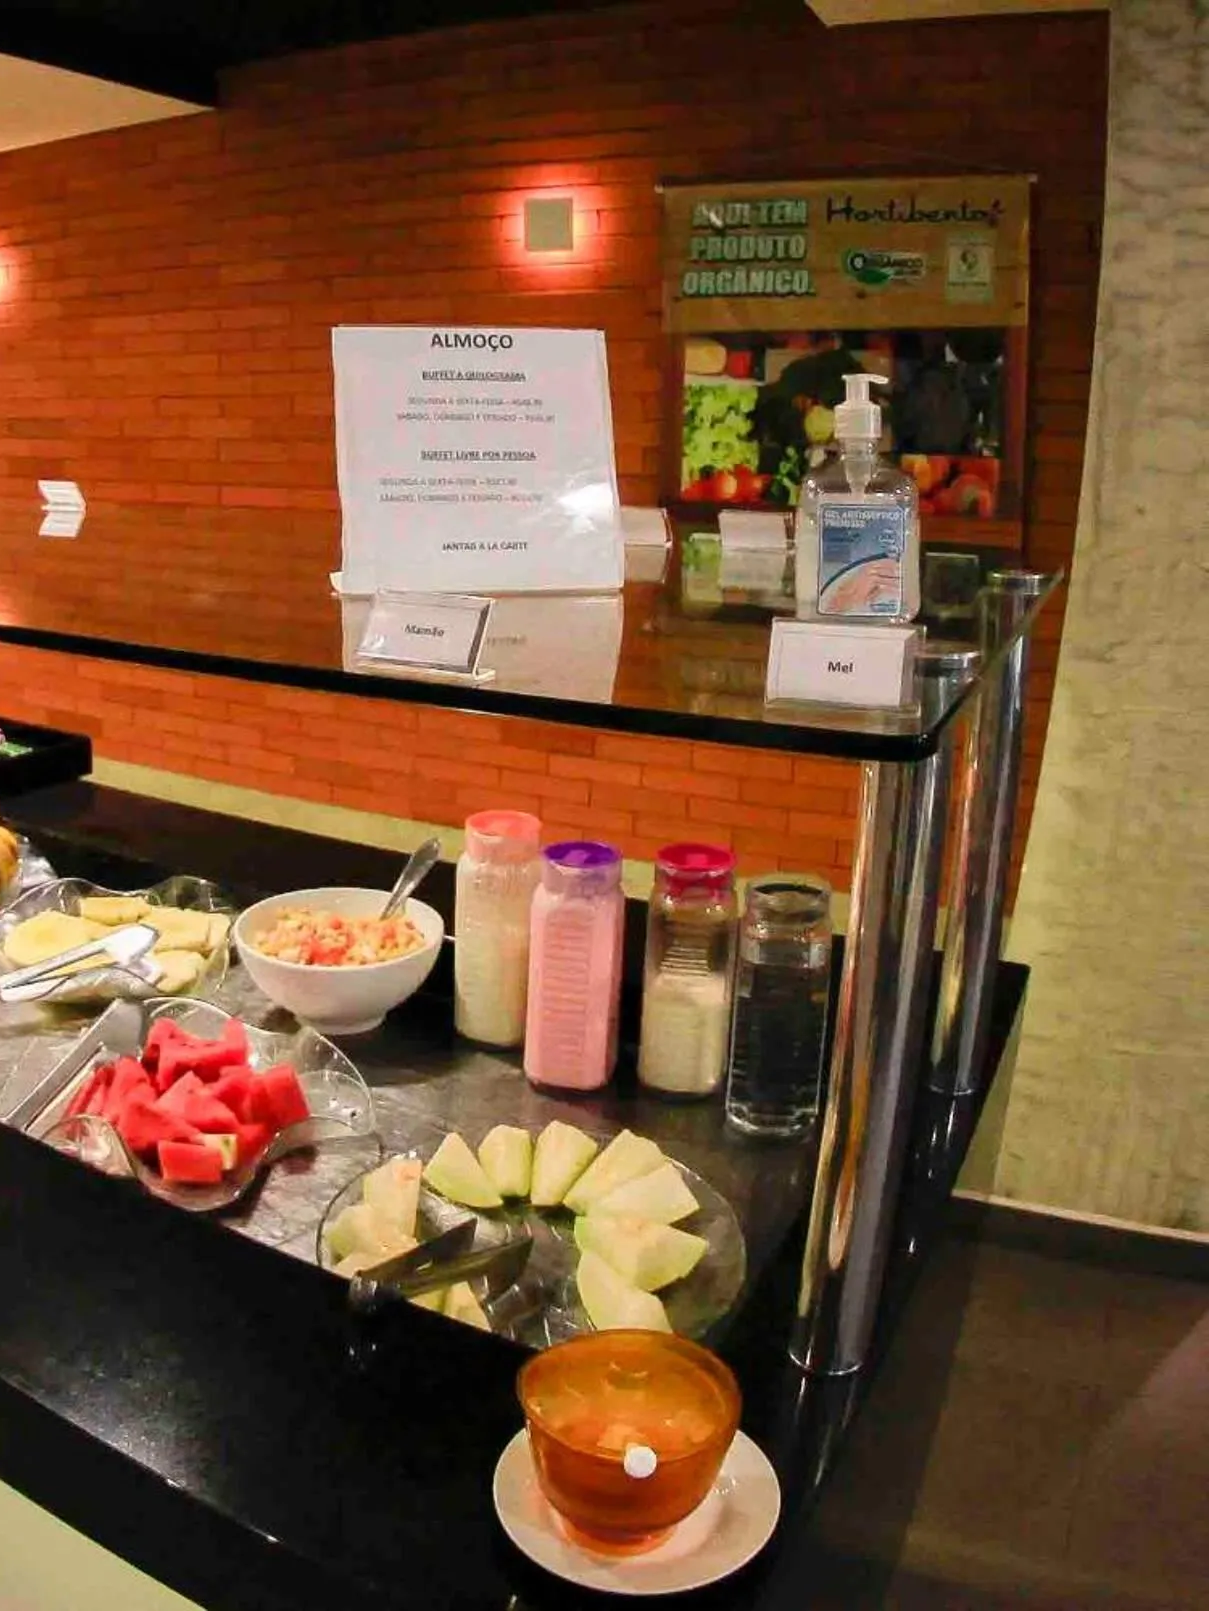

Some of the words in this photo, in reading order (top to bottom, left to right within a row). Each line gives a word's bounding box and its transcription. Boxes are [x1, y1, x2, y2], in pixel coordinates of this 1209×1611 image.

[757, 199, 809, 225] TEM
[689, 234, 807, 261] PRODUTO
[430, 332, 513, 352] ALMOÇO
[827, 661, 854, 674] Mel
